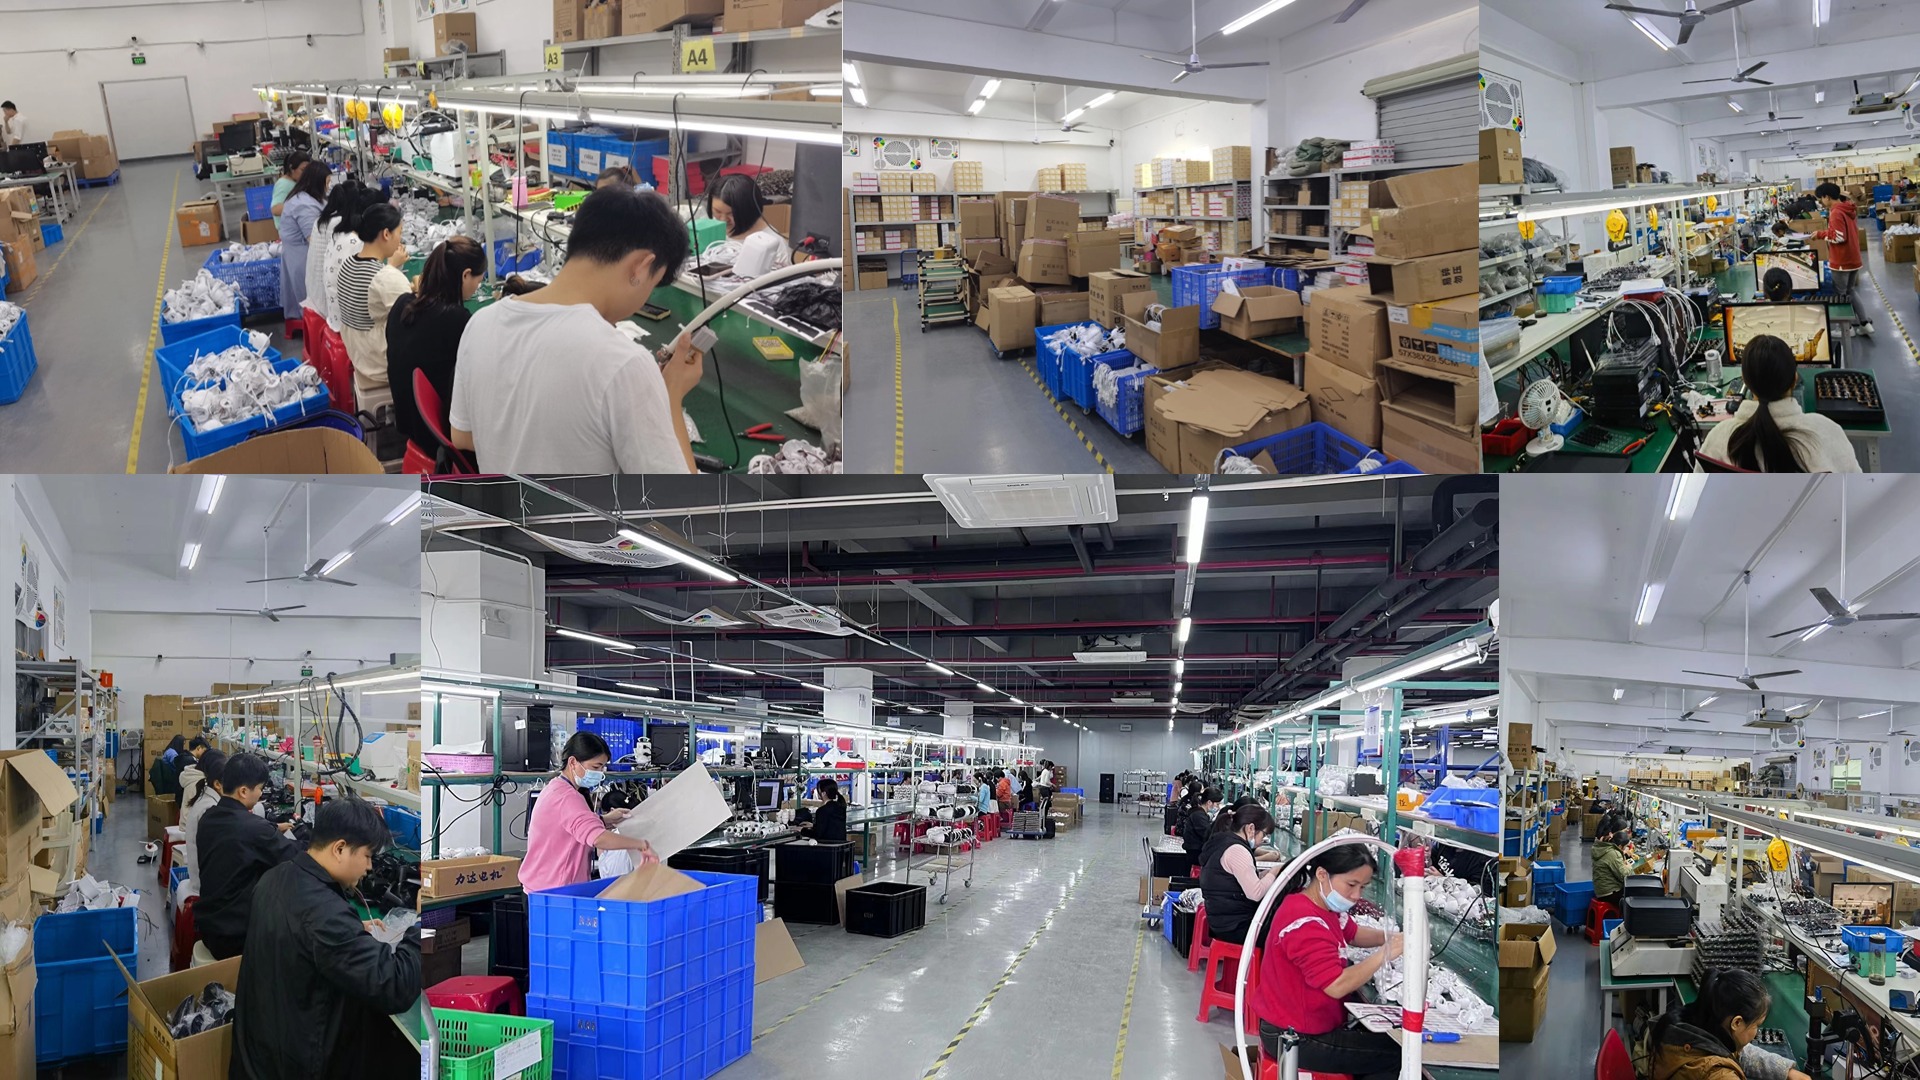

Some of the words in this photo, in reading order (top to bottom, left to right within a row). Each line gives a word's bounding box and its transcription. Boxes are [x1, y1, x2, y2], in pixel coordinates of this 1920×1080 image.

[547, 52, 559, 64] A3
[687, 48, 708, 66] A4
[455, 869, 503, 886] 力达电机
